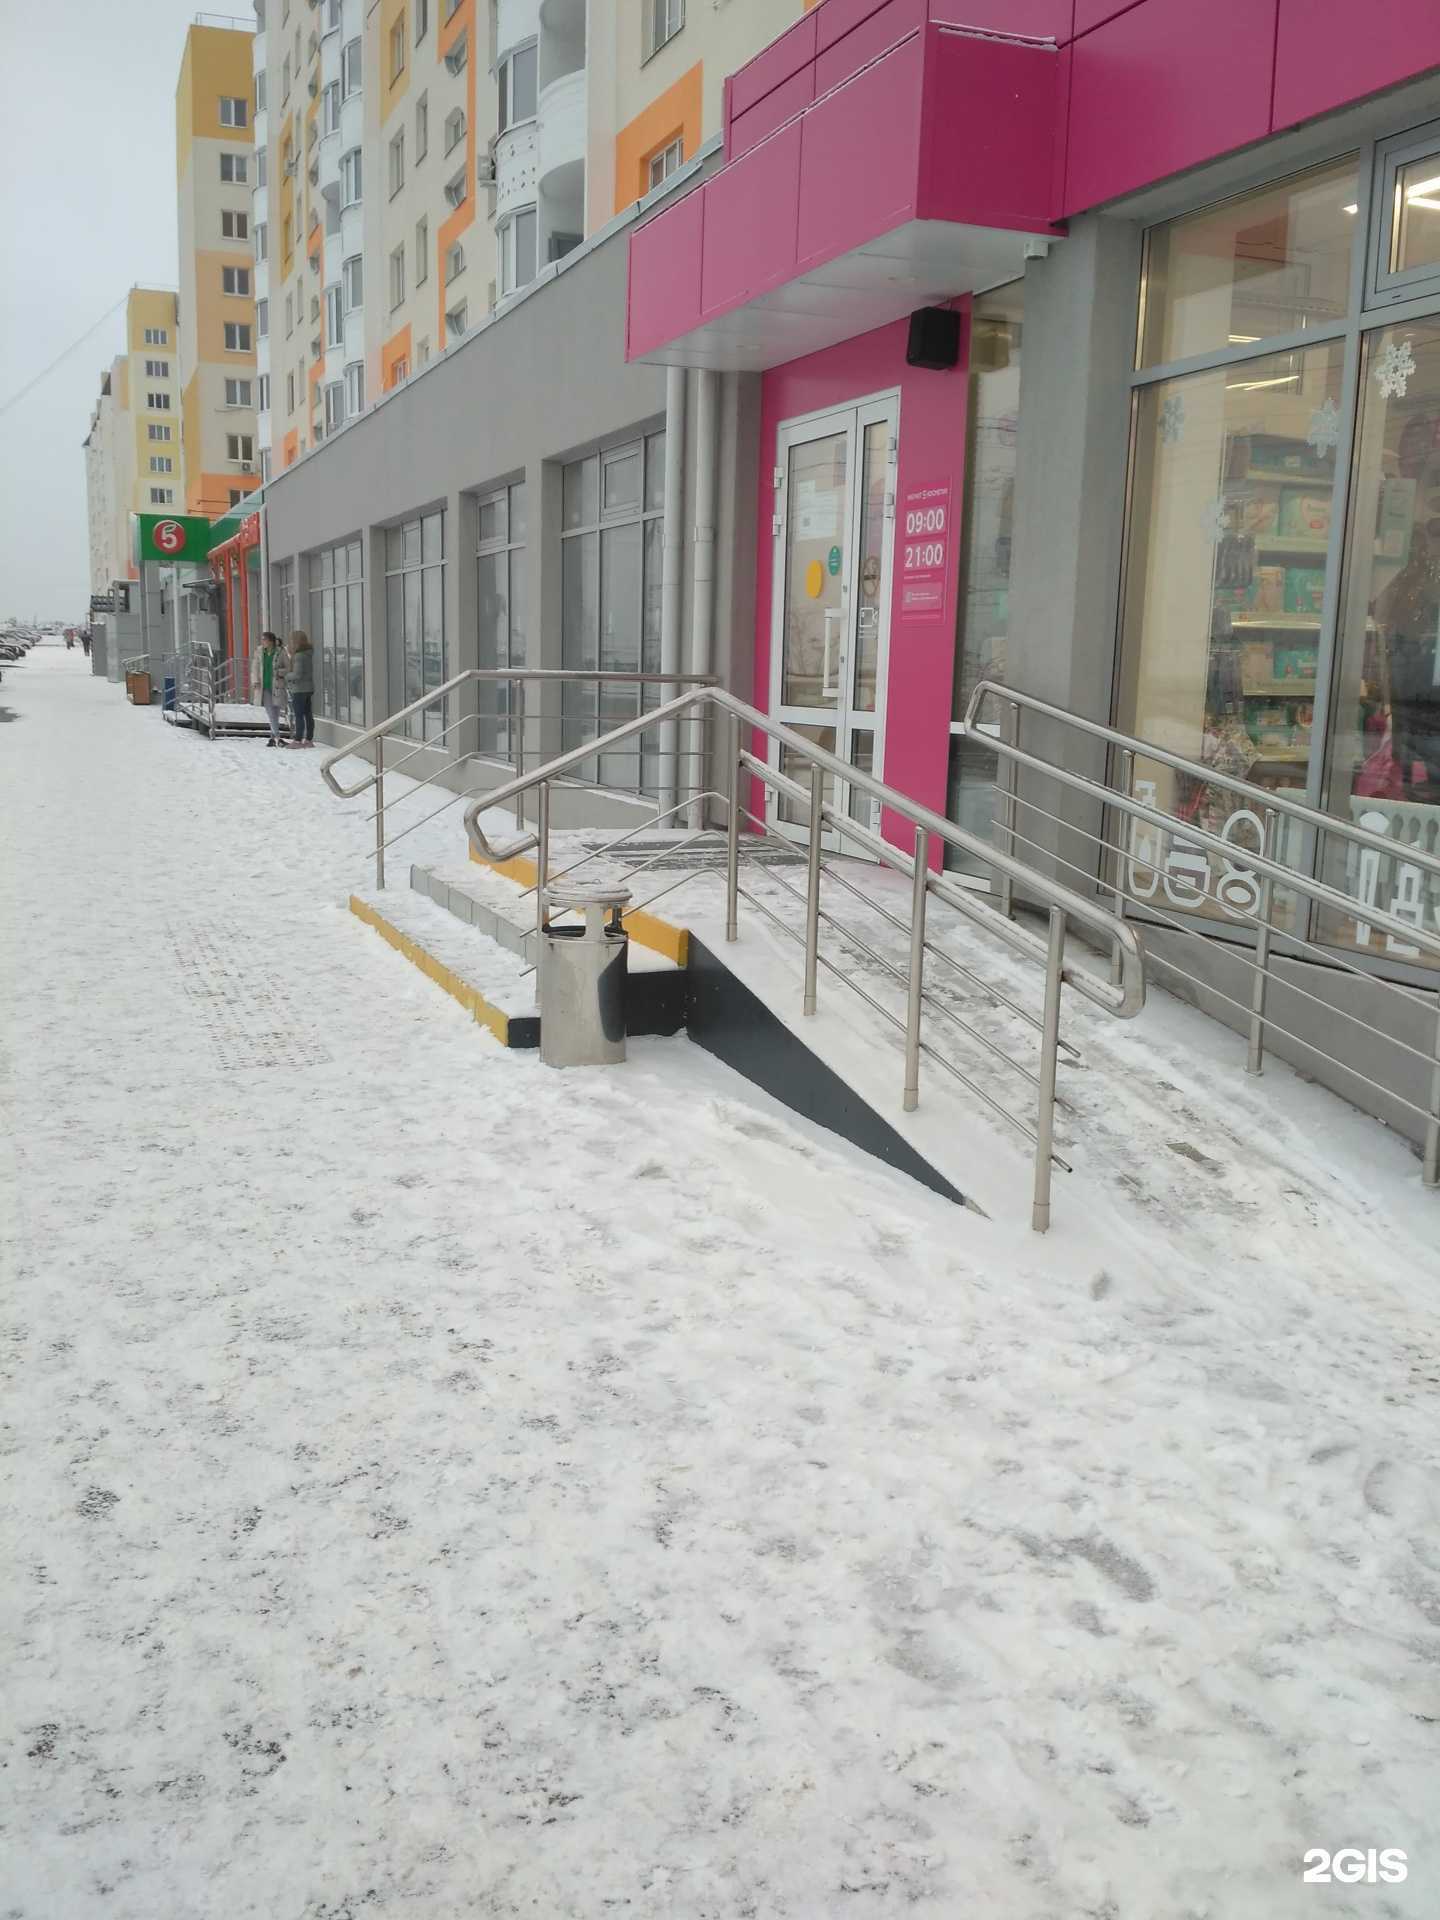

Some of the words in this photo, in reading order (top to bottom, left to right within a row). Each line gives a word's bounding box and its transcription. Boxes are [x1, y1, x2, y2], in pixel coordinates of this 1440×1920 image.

[906, 508, 945, 534] 09:00
[161, 523, 177, 549] 5
[904, 543, 943, 568] 21:00
